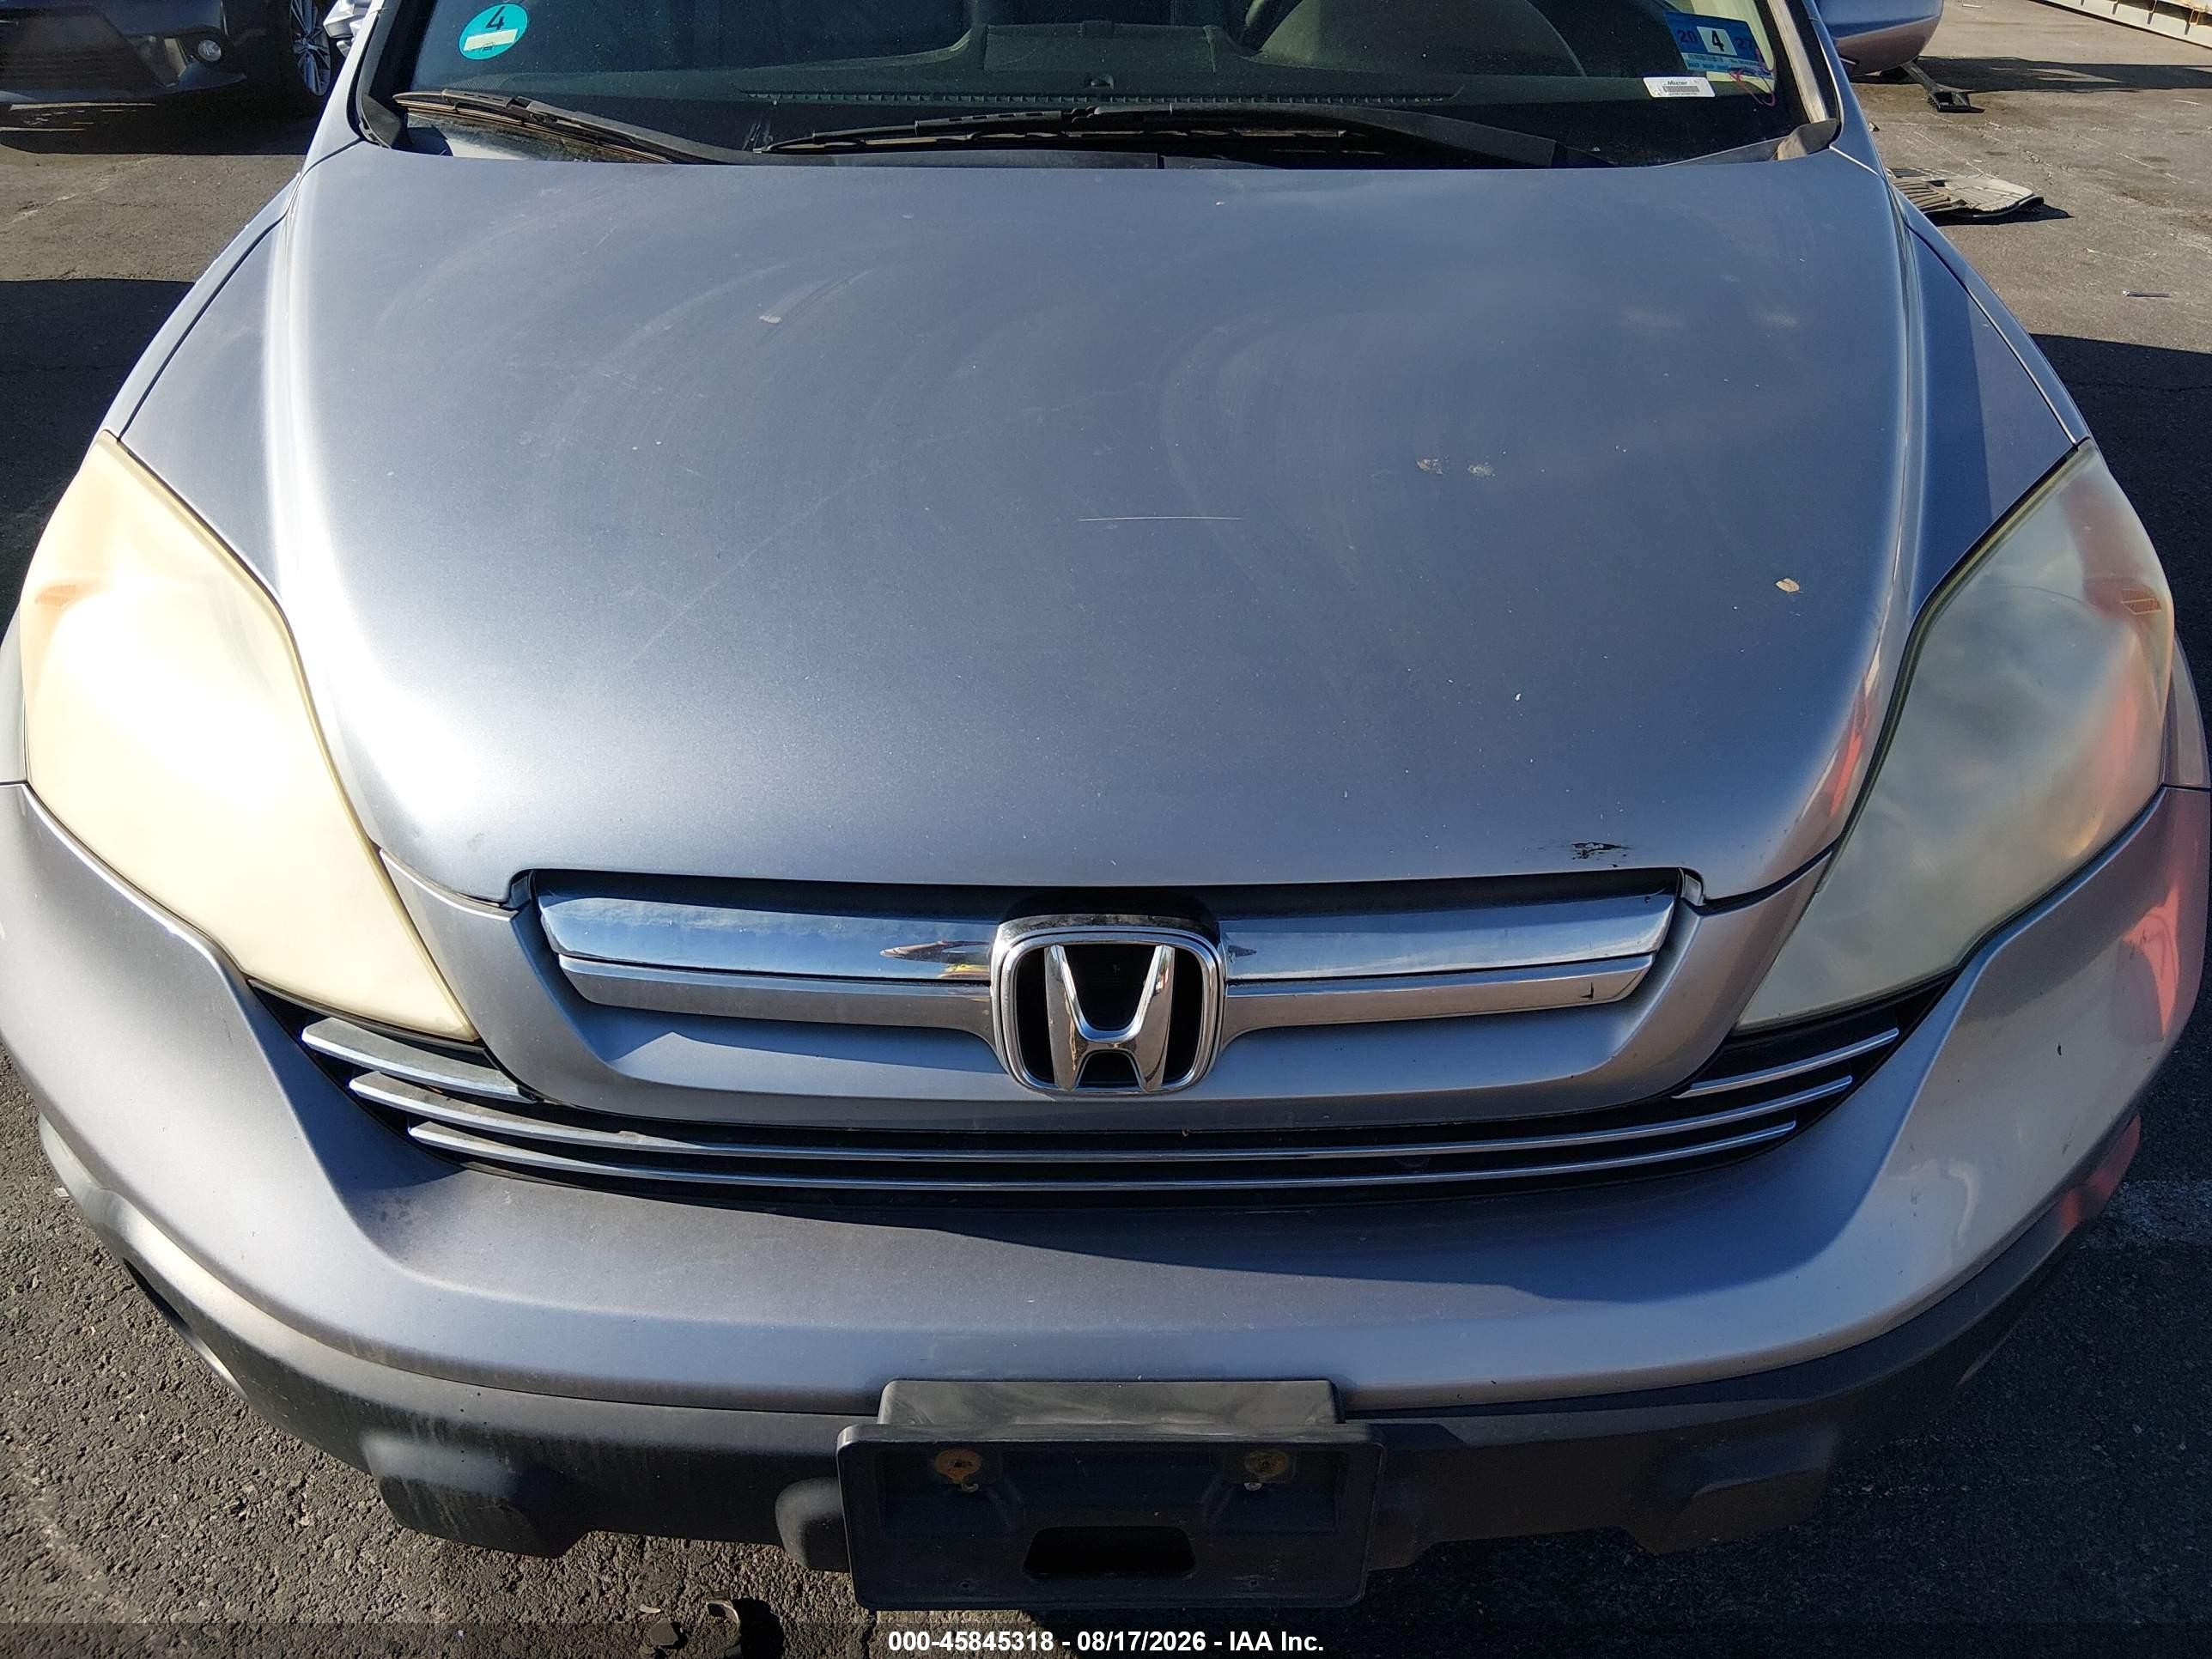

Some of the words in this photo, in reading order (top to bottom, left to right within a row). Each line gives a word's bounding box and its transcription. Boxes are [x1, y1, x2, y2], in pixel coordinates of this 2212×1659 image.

[486, 5, 506, 31] 4
[1676, 29, 1698, 44] 20
[1711, 30, 1725, 52] 4
